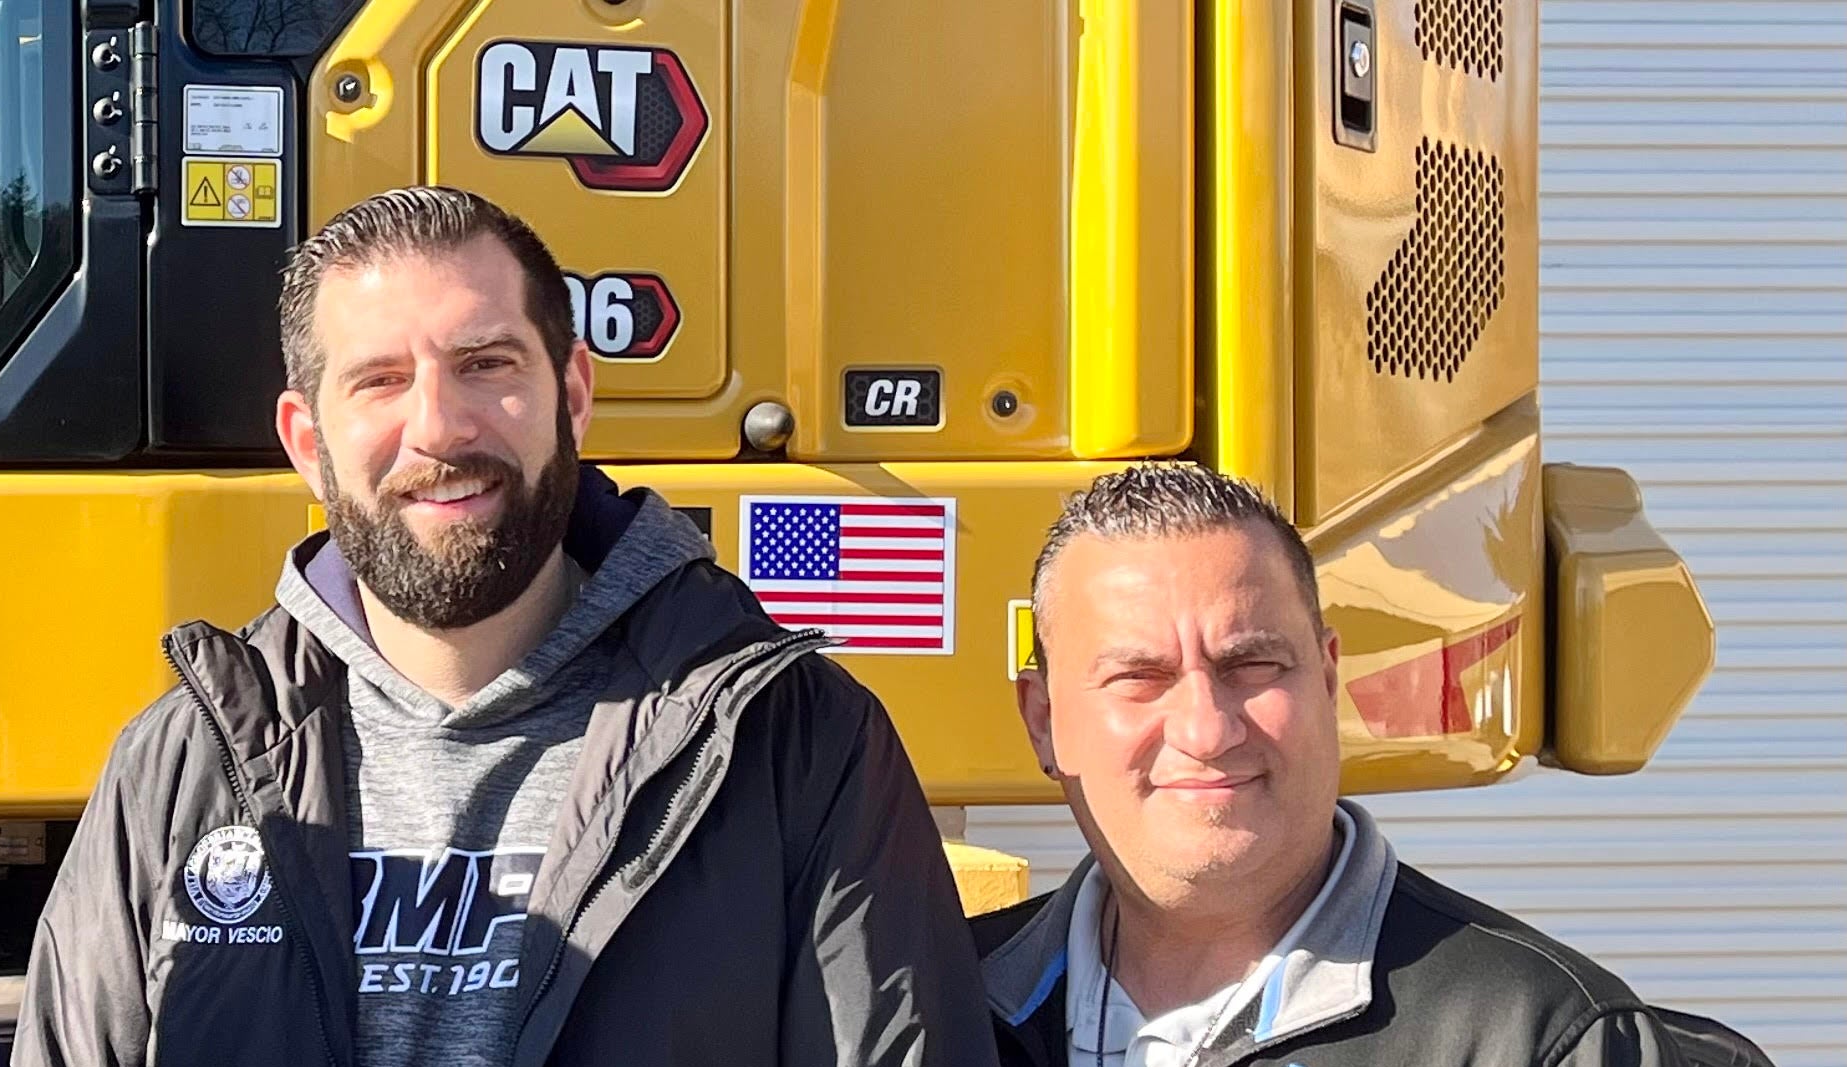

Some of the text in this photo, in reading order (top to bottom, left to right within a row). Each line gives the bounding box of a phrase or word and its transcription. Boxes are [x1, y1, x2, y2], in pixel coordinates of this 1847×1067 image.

[479, 43, 652, 156] CAT
[864, 379, 922, 417] CR
[161, 920, 283, 944] MAYOR VESCIO
[358, 963, 441, 994] EST.
